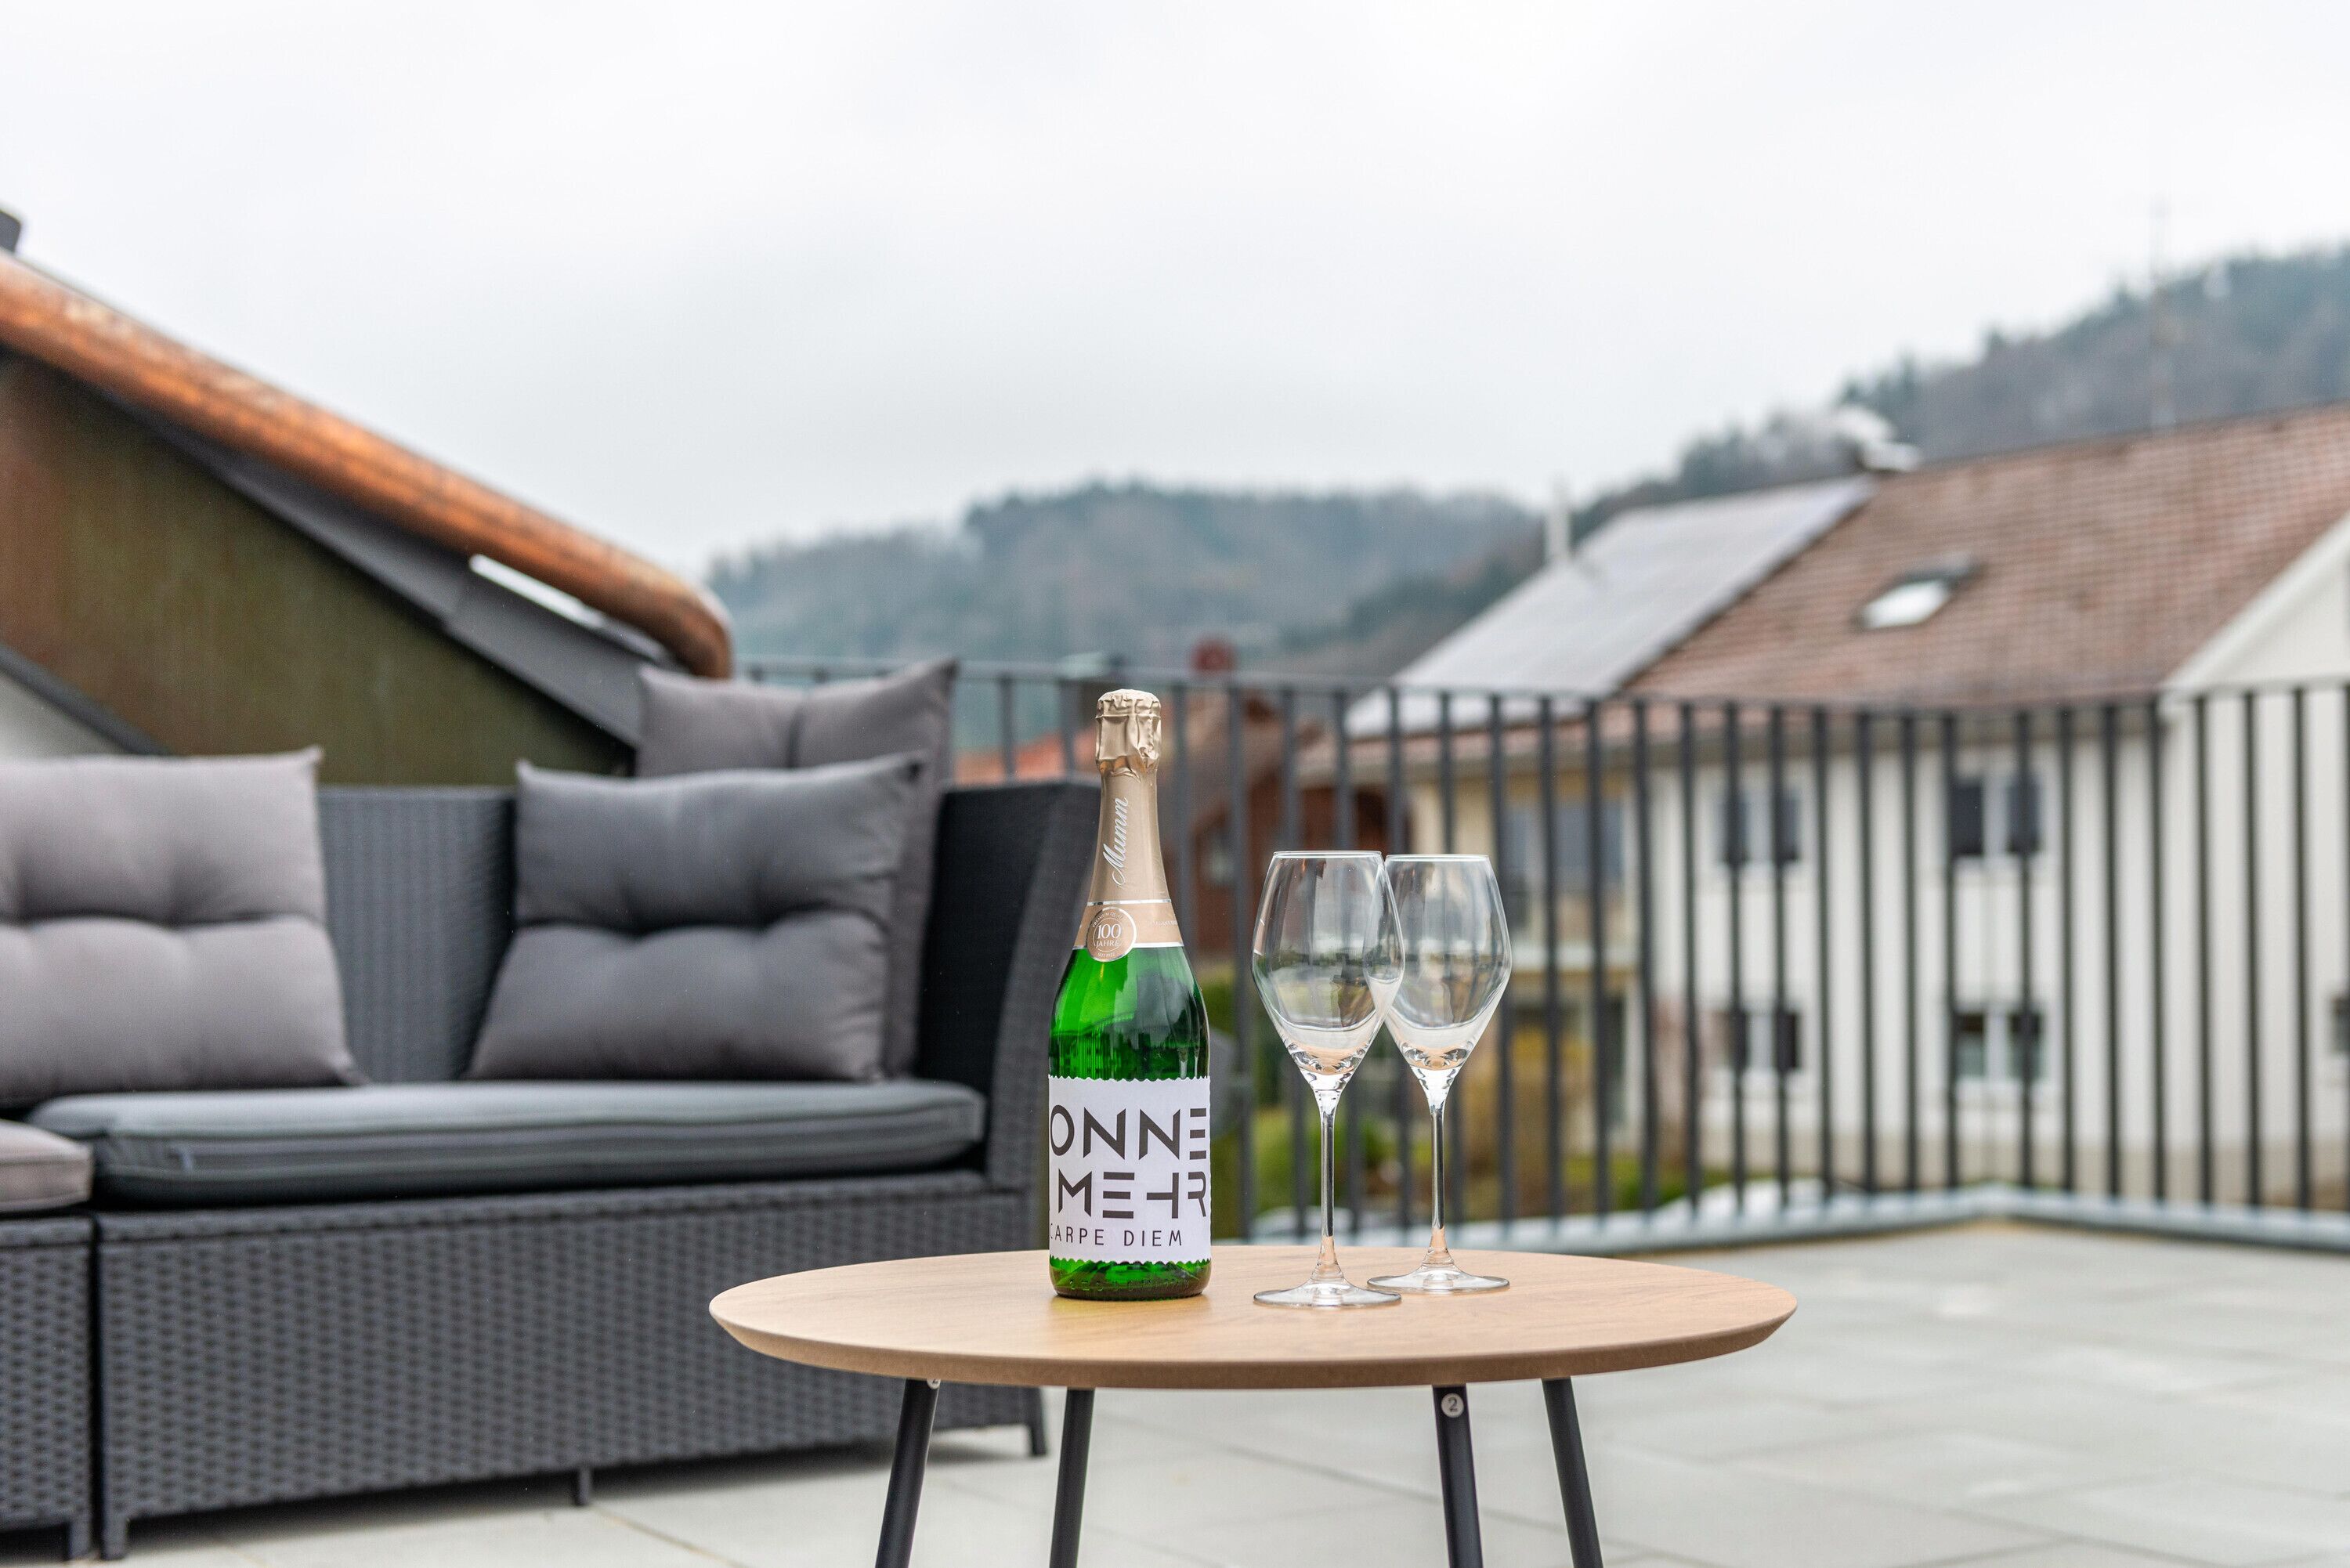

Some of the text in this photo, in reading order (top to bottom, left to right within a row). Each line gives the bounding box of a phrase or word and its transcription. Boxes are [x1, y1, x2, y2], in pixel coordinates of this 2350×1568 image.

[1102, 797, 1128, 886] Mumm
[1097, 924, 1121, 939] 100
[1050, 1105, 1207, 1160] ONNE
[1058, 1168, 1207, 1219] MEHR
[1124, 1230, 1182, 1247] DIEM
[1448, 1396, 1459, 1412] 2
